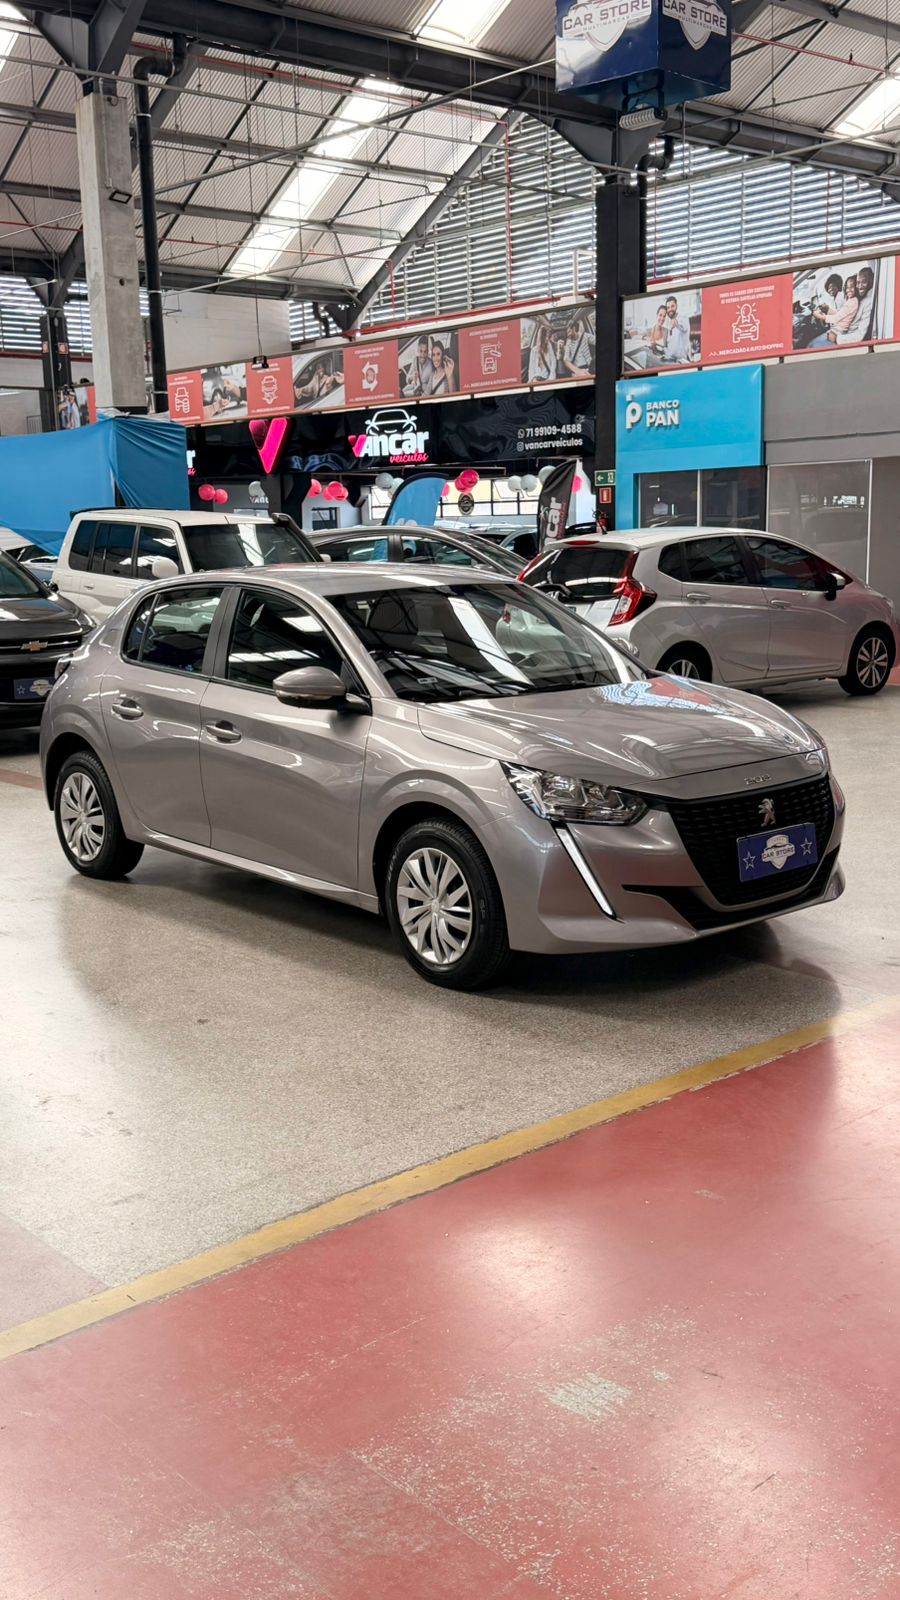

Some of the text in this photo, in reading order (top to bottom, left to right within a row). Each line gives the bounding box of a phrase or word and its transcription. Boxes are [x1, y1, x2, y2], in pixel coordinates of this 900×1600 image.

[563, 0, 651, 31] CAR STORE
[663, 0, 727, 29] CAR STORE
[646, 399, 680, 411] BANCO
[646, 410, 680, 427] PAN
[526, 423, 583, 438] 71 99109-4588
[762, 846, 794, 859] CAR STORE
